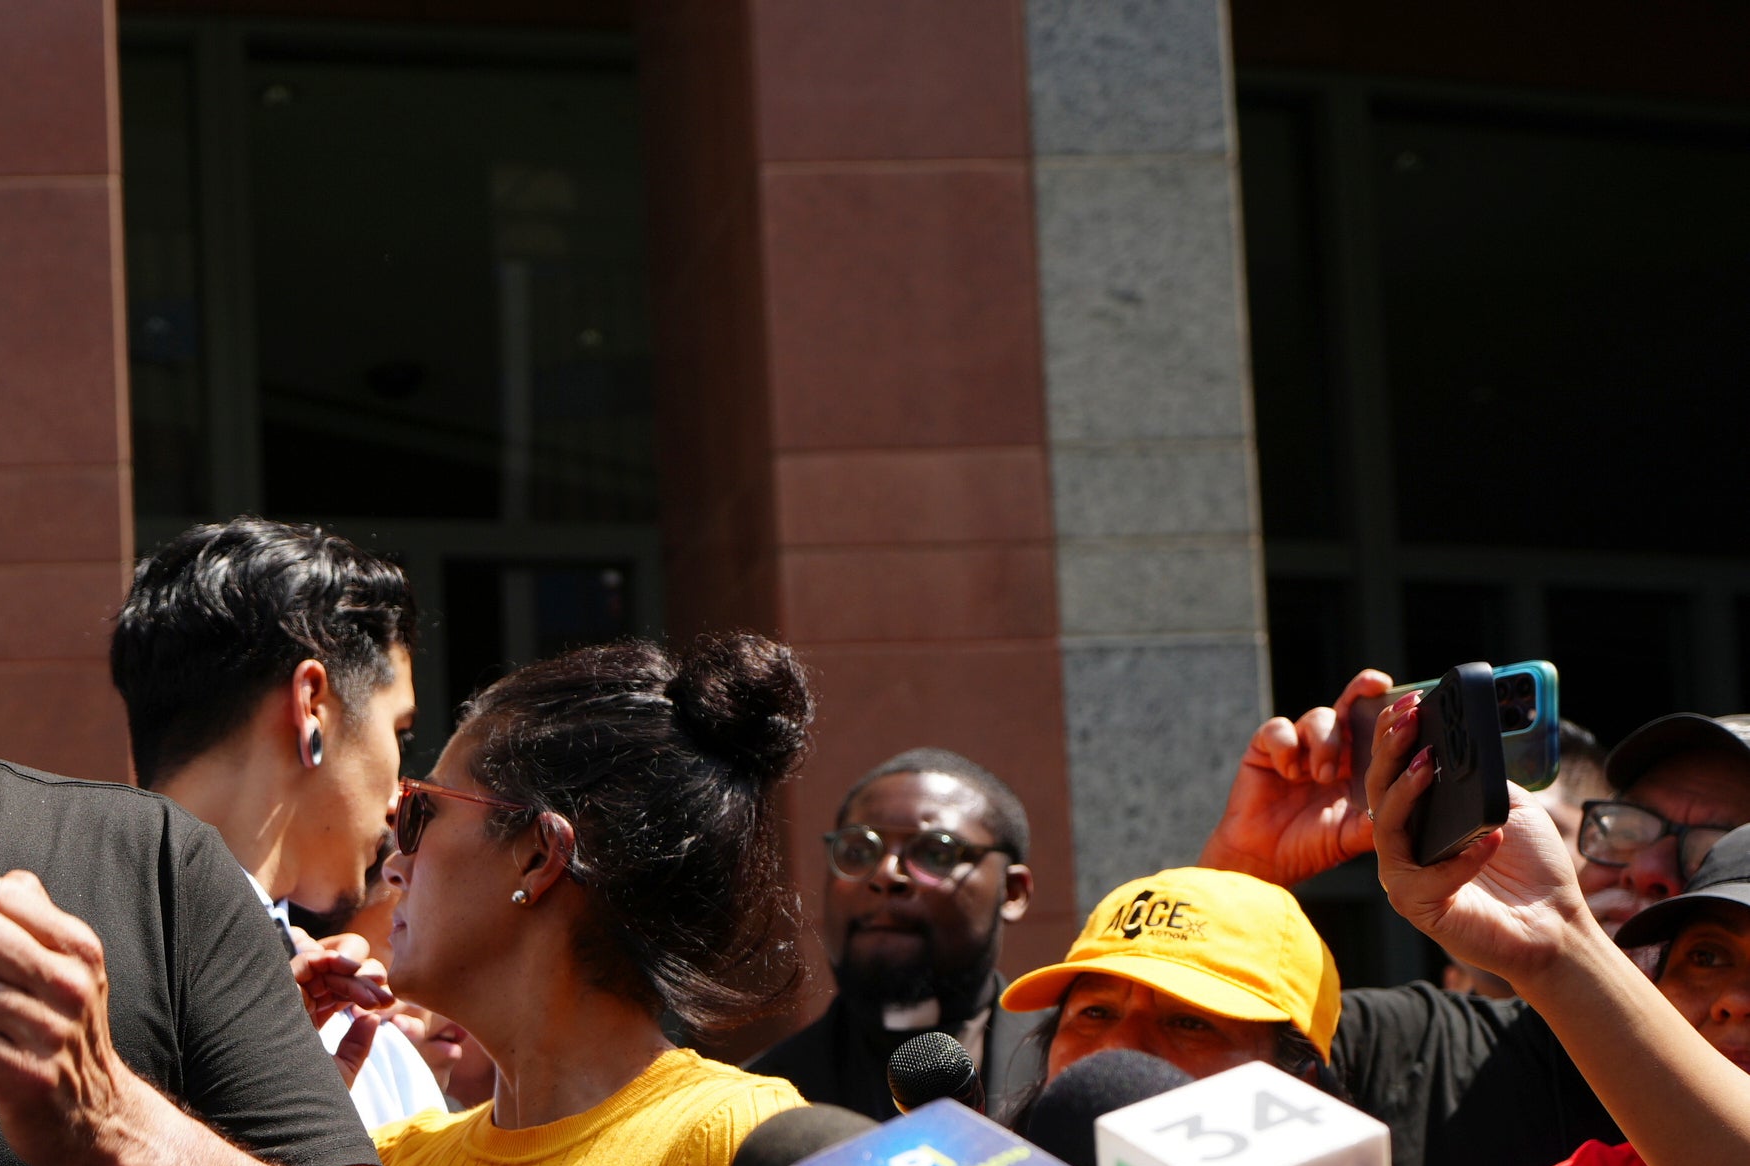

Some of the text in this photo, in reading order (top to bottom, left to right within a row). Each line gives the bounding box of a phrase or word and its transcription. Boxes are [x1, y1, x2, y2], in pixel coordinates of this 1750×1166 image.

[1103, 898, 1191, 934] ACCE
[1147, 929, 1188, 941] ACTION
[1154, 1090, 1324, 1162] 34
